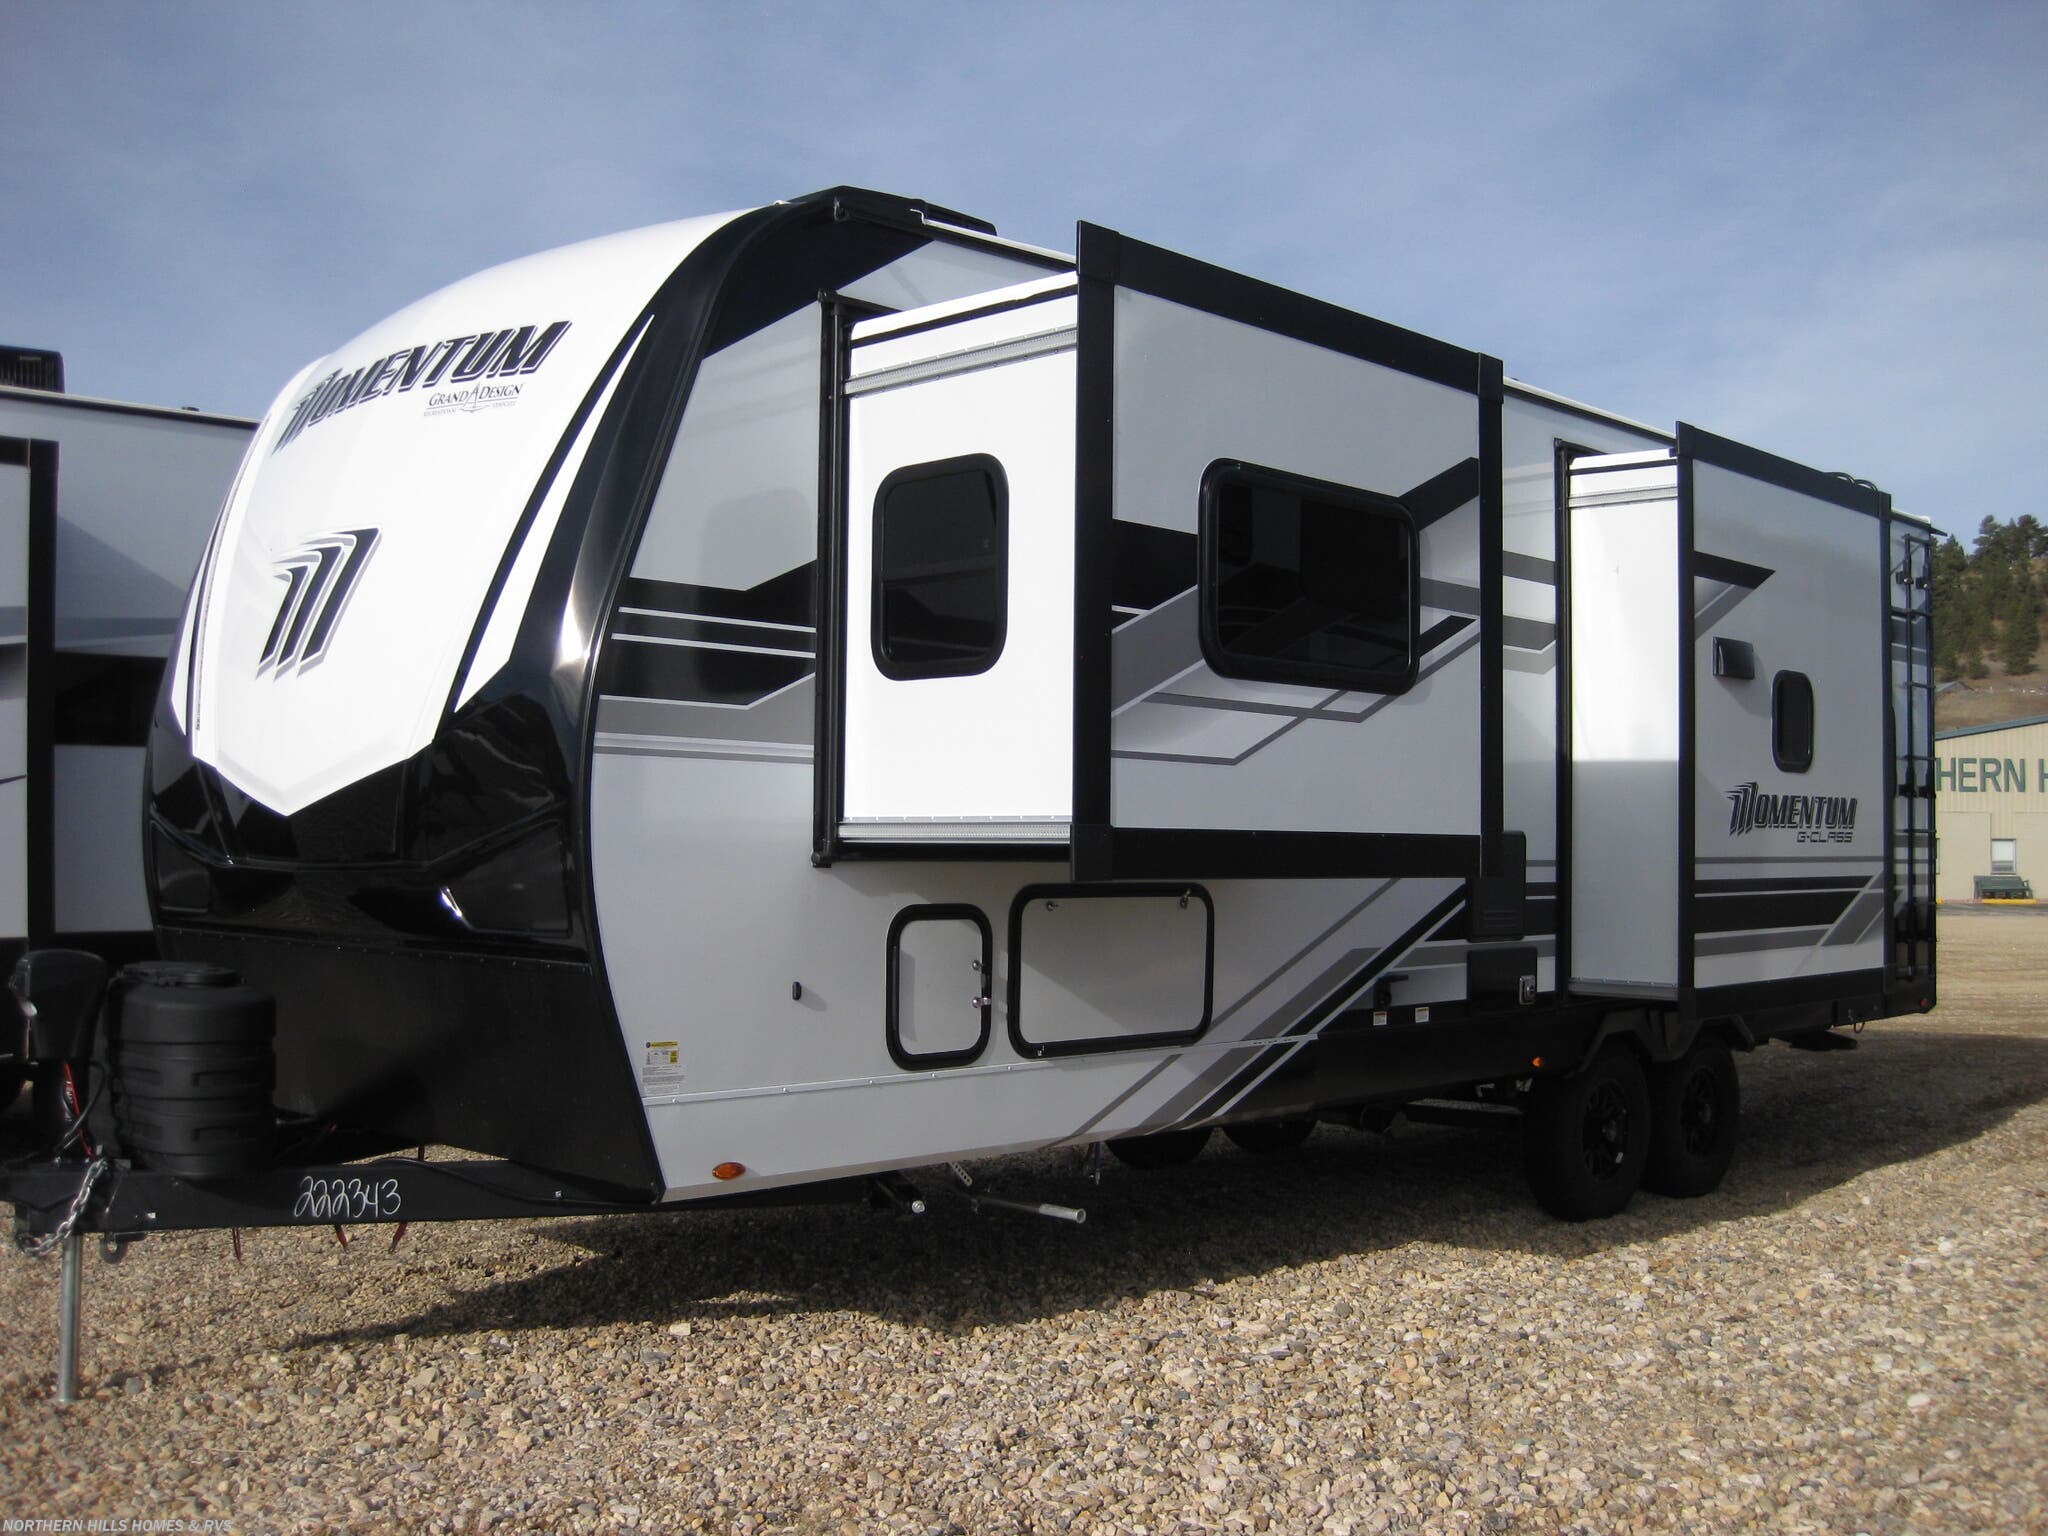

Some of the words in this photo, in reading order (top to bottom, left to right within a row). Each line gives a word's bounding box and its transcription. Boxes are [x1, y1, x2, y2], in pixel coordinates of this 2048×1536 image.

[272, 320, 572, 455] MOMENTUM
[1724, 781, 1857, 836] MOMENTUM
[294, 1175, 402, 1218] 222343
